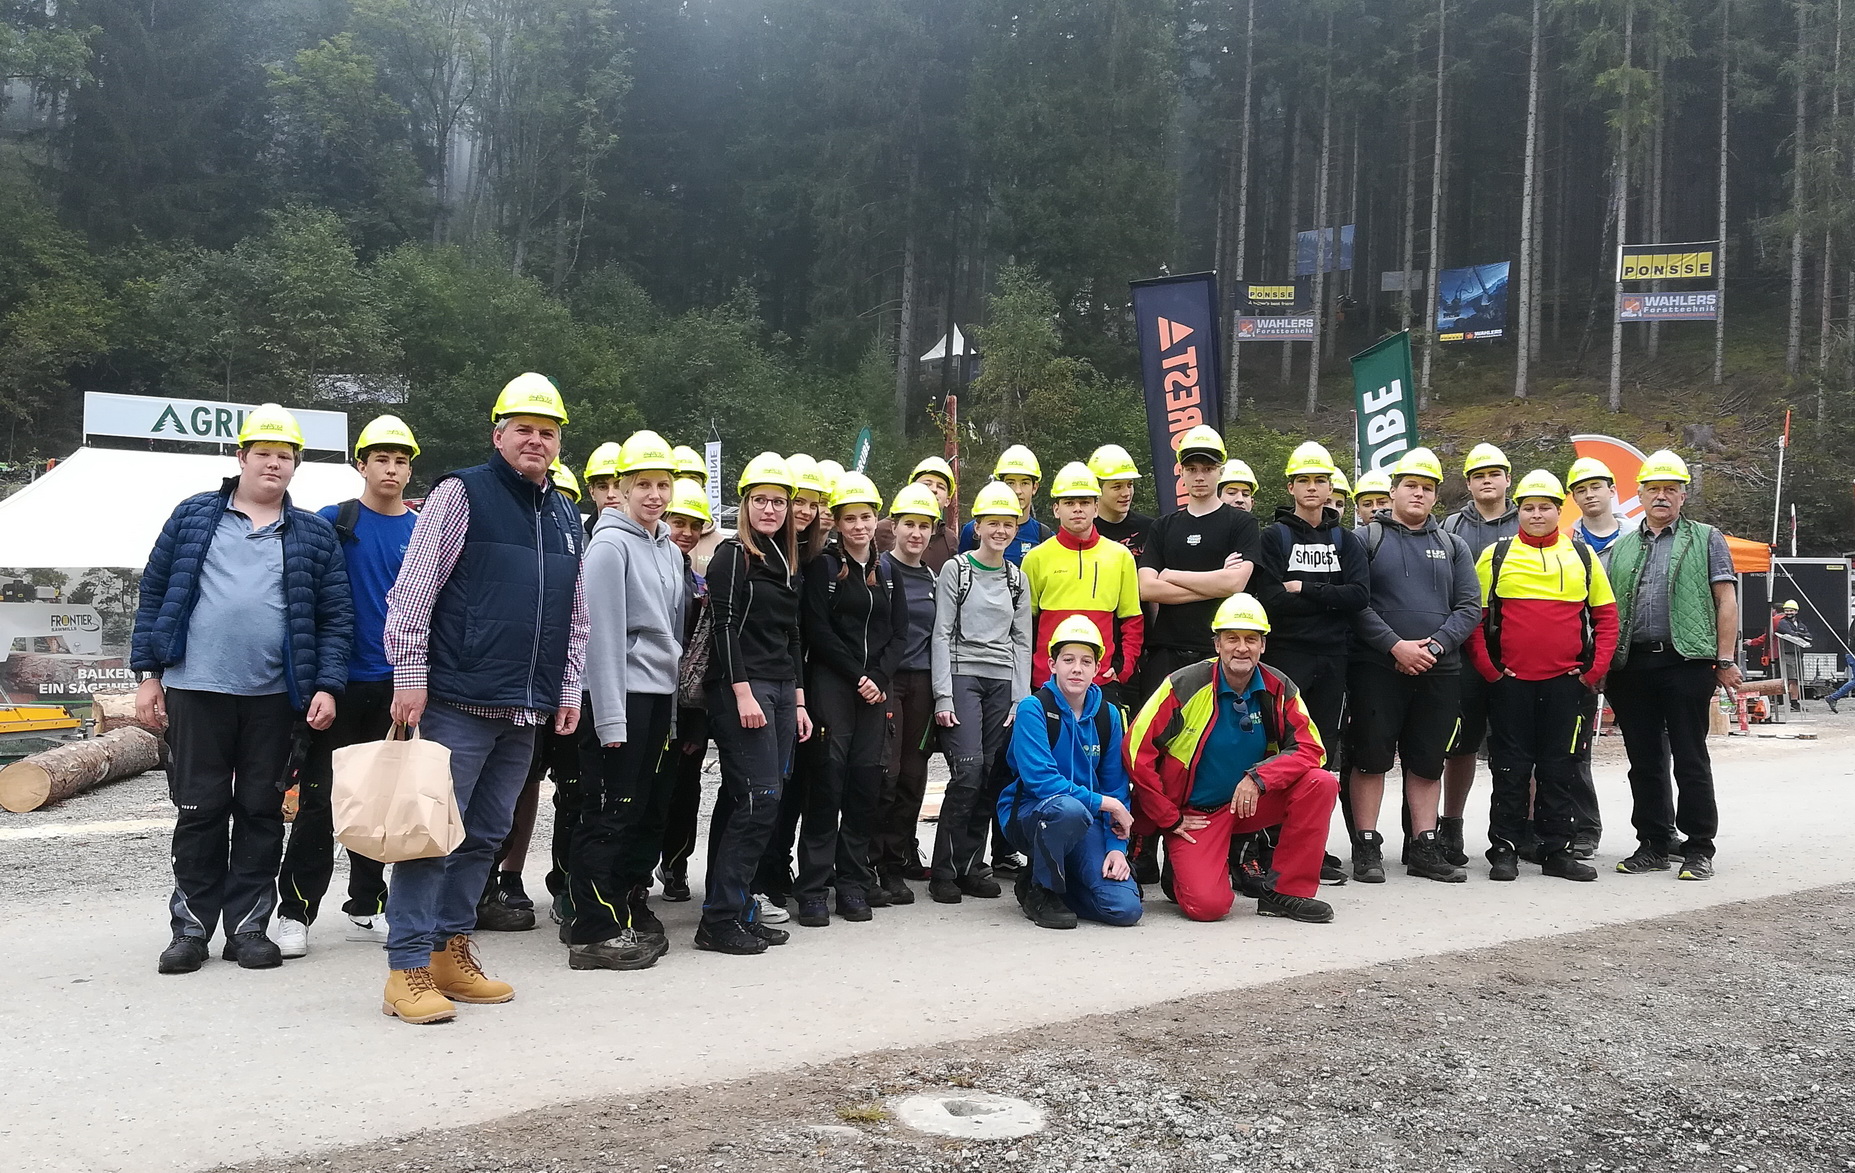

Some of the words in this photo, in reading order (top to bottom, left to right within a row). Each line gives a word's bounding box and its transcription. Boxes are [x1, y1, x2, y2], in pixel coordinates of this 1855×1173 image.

[1625, 263, 1709, 276] PONSSE
[1645, 295, 1716, 306] WAHLERS
[1644, 305, 1715, 313] Forsttechnik
[1257, 319, 1313, 328] WAHLERS
[1296, 550, 1334, 568] snipes
[51, 615, 92, 626] FRONTIER
[39, 684, 63, 694] EIN
